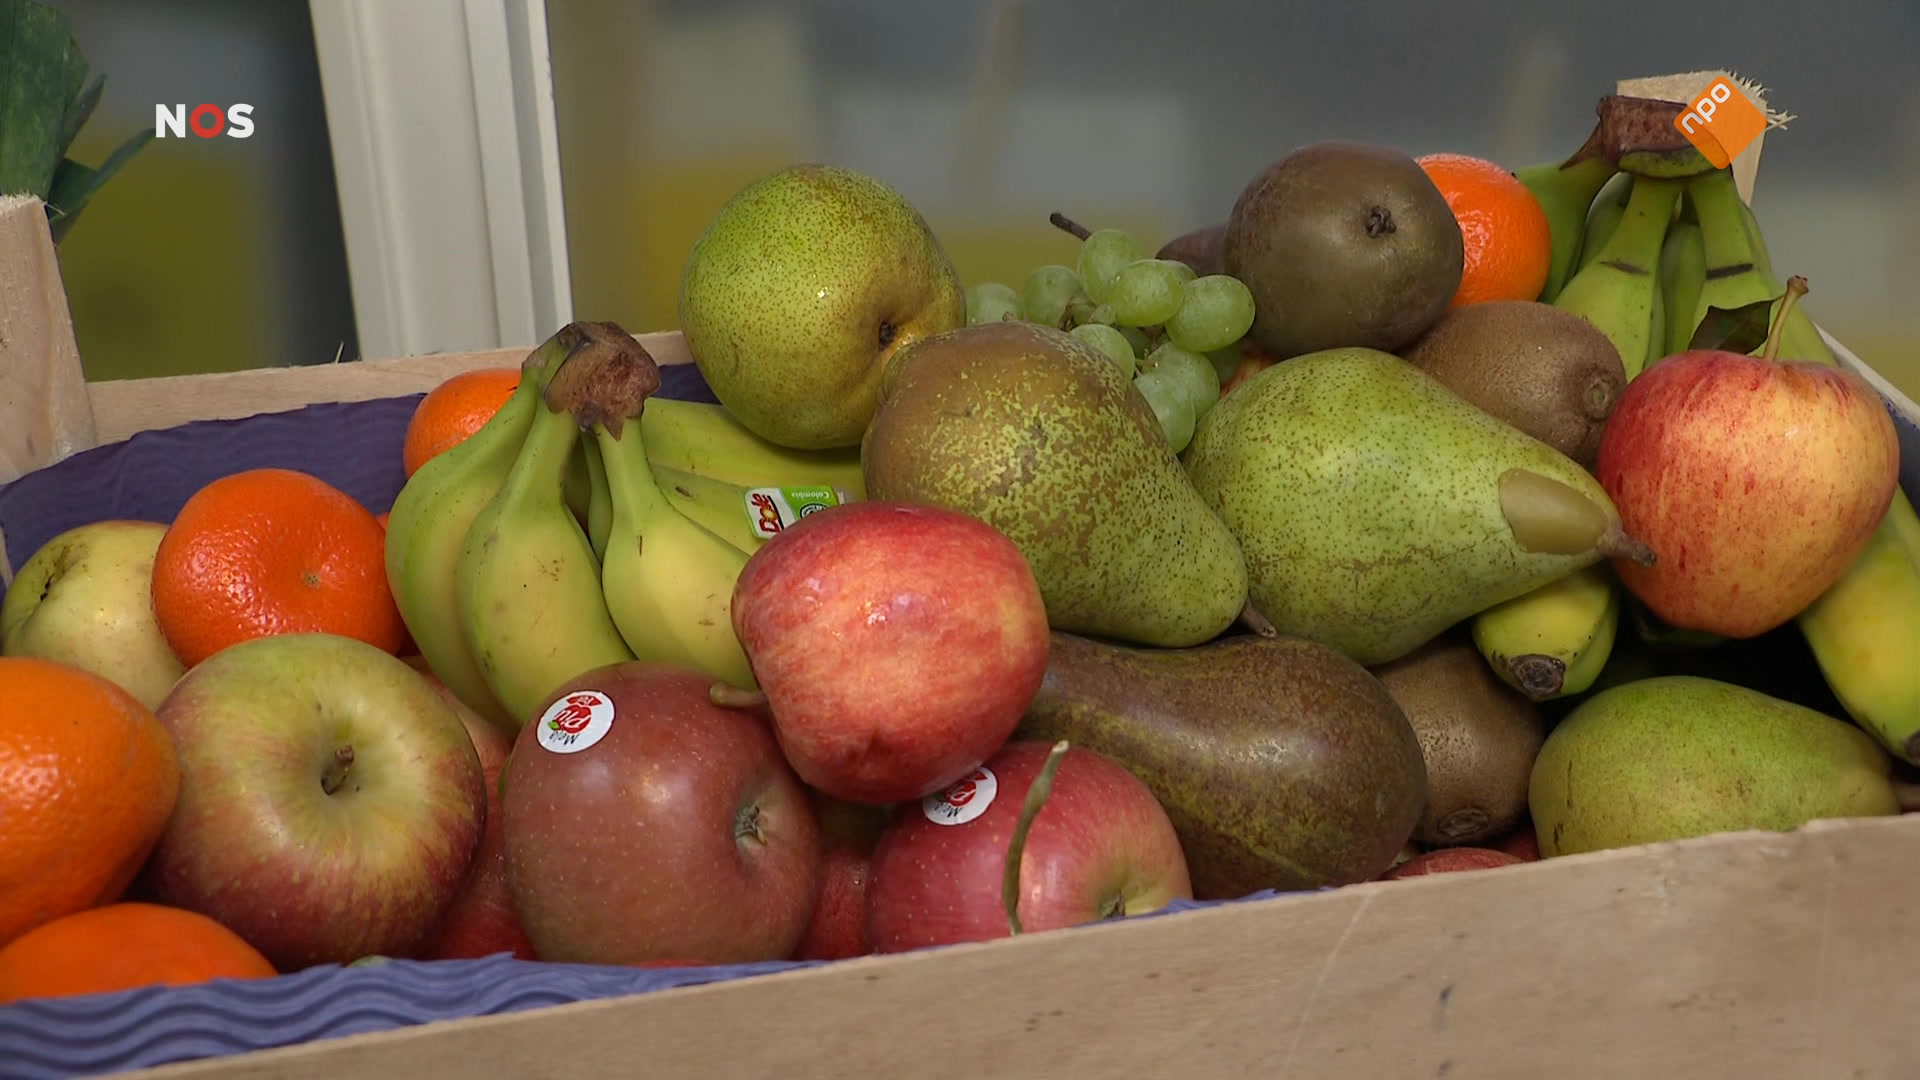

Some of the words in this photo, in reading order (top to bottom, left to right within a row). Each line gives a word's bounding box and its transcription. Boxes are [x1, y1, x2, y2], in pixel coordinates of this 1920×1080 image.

[791, 490, 830, 500] Colombia
[751, 493, 781, 533] Dole
[549, 731, 580, 746] Mela
